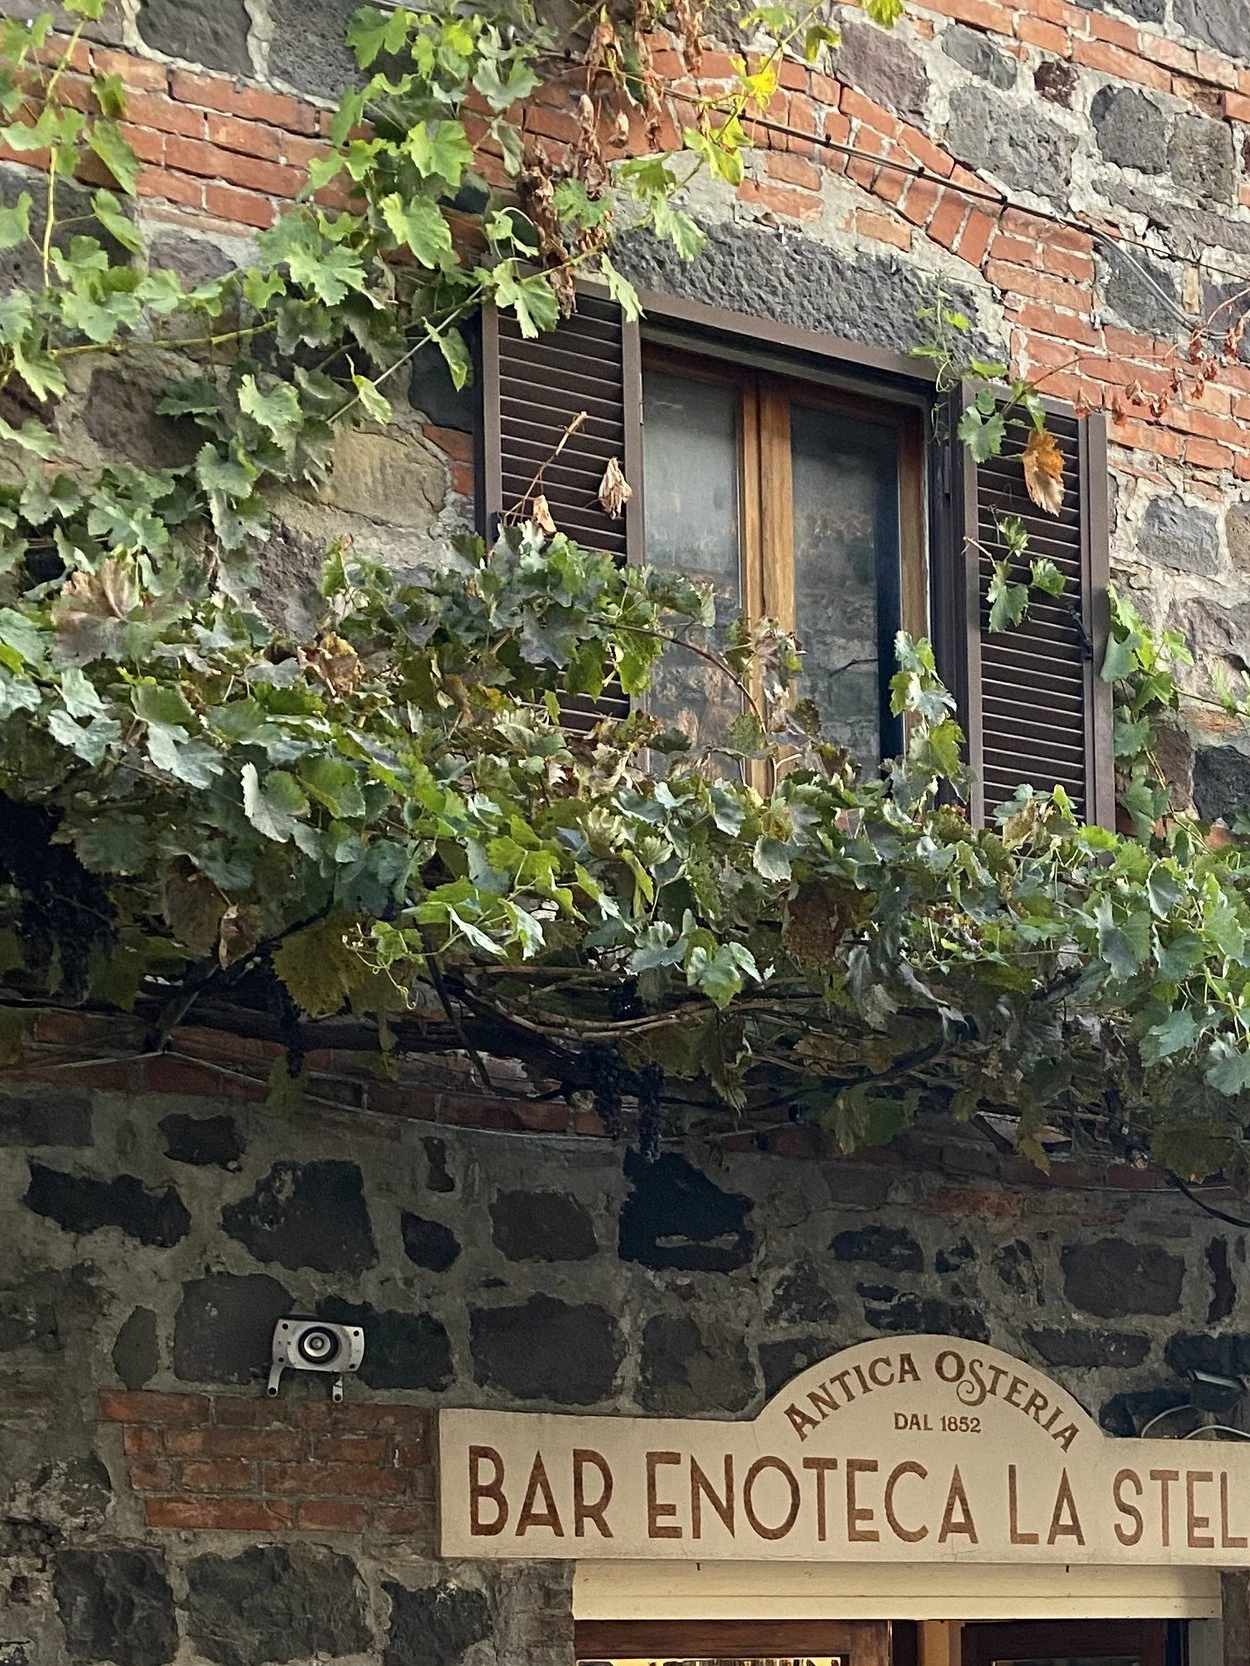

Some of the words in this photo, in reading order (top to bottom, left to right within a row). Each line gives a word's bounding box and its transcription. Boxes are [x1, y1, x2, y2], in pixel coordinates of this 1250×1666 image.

[783, 1352, 922, 1442] ANTICA
[934, 1350, 1080, 1453] OSTERIA
[894, 1412, 933, 1431] DAL
[940, 1414, 982, 1433] 1852
[468, 1445, 614, 1538] BAR
[645, 1451, 979, 1544] ENOTECA
[1007, 1464, 1086, 1546] LA
